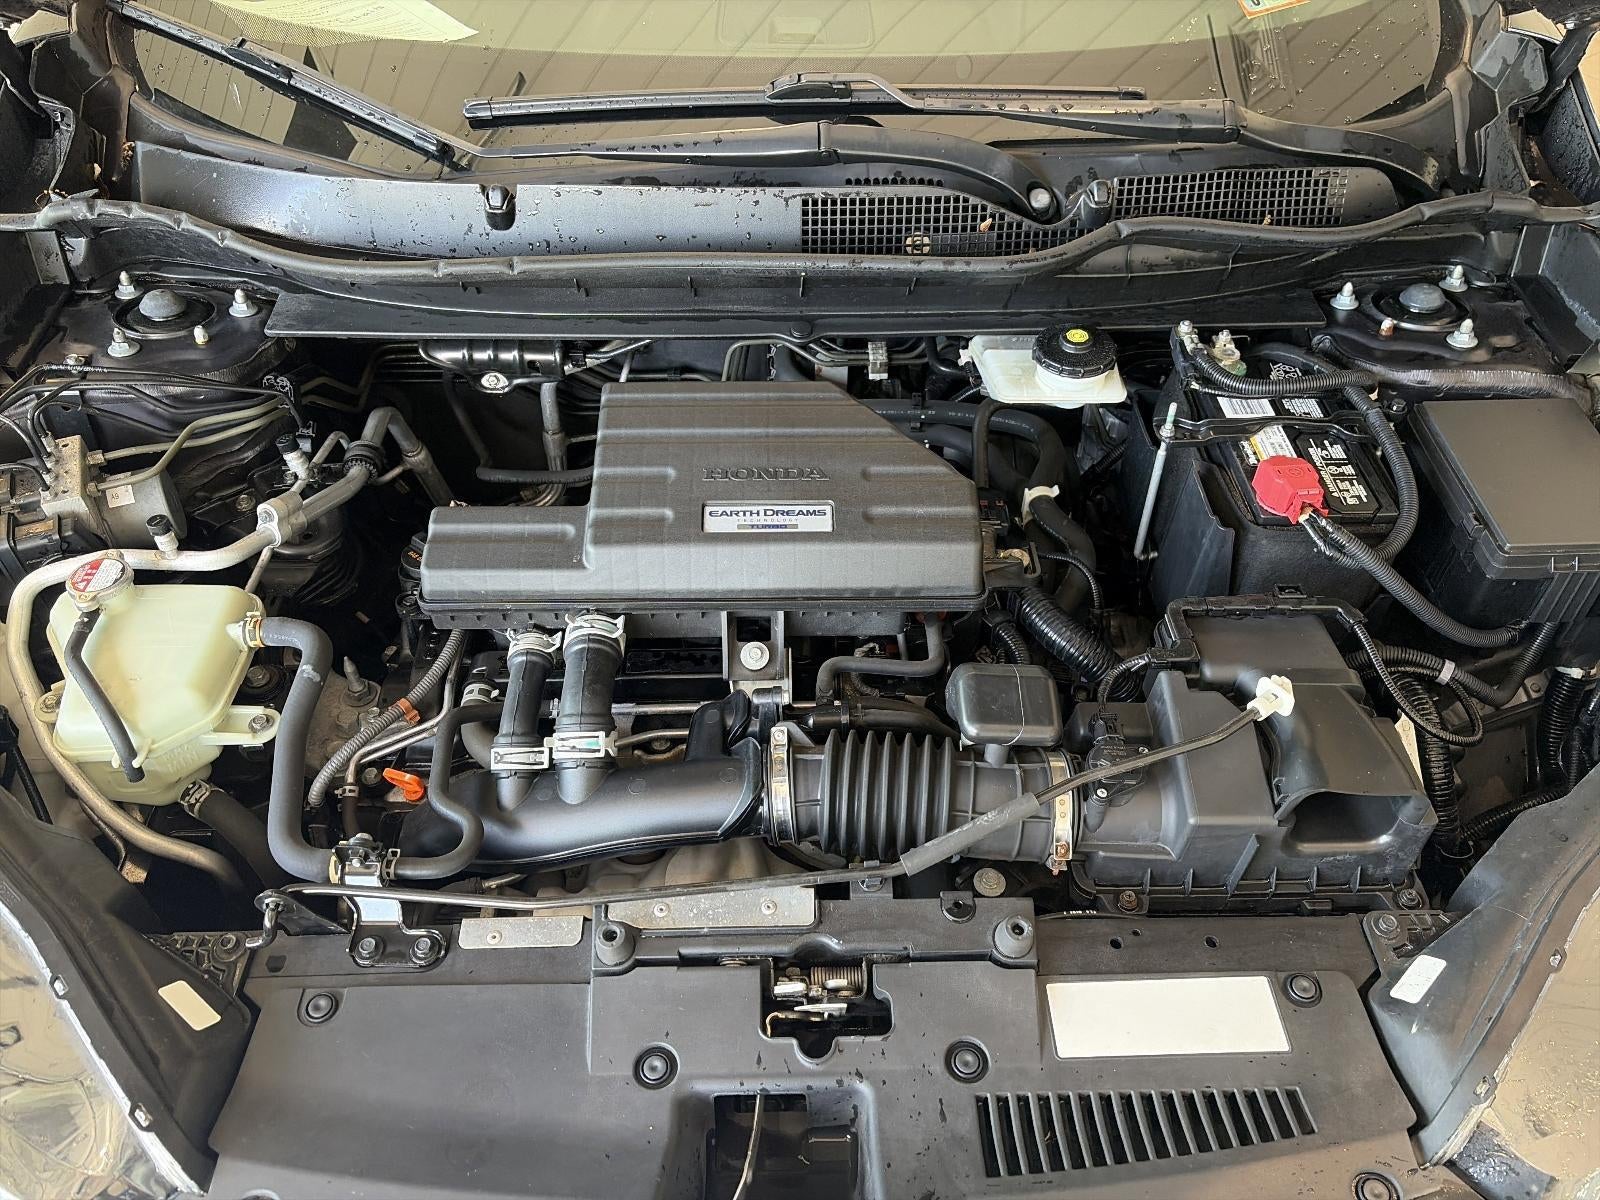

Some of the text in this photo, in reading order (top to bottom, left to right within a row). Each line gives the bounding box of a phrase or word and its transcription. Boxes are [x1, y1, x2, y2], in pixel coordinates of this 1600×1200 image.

[702, 466, 830, 481] HONDA
[1320, 470, 1335, 491] DANGER
[708, 508, 827, 518] EARTH DREAMS
